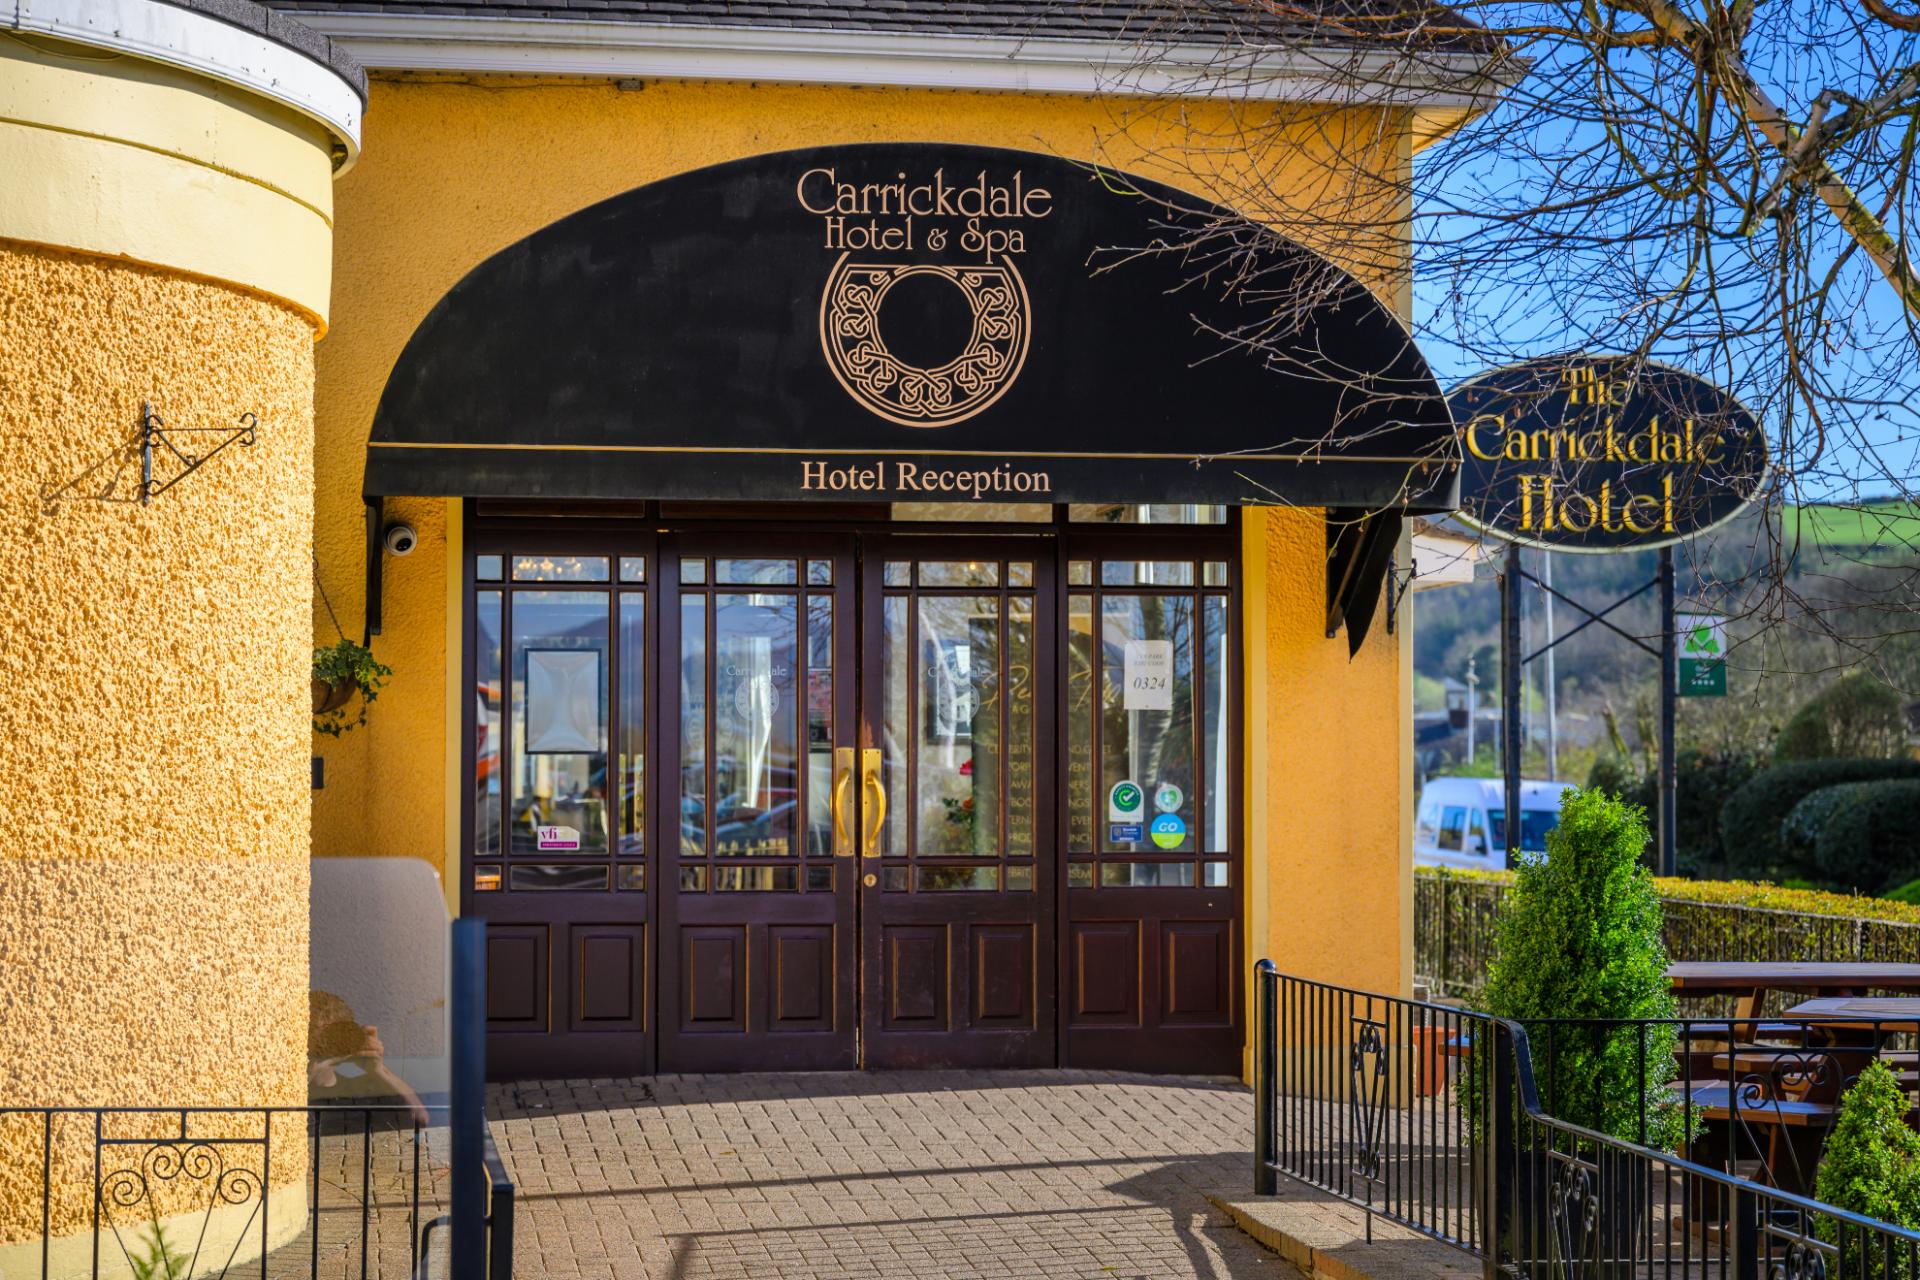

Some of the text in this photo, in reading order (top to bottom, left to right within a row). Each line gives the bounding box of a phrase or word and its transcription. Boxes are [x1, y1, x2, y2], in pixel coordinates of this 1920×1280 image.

[797, 168, 1053, 218] Carrickdale
[824, 215, 1026, 264] Hotel & Spa
[1561, 366, 1630, 406] The
[1466, 413, 1726, 464] Carrickdale
[800, 460, 1052, 499] Hotel Reception
[1517, 471, 1677, 533] Hotel
[1133, 676, 1166, 690] 0324
[1158, 822, 1178, 833] GO
